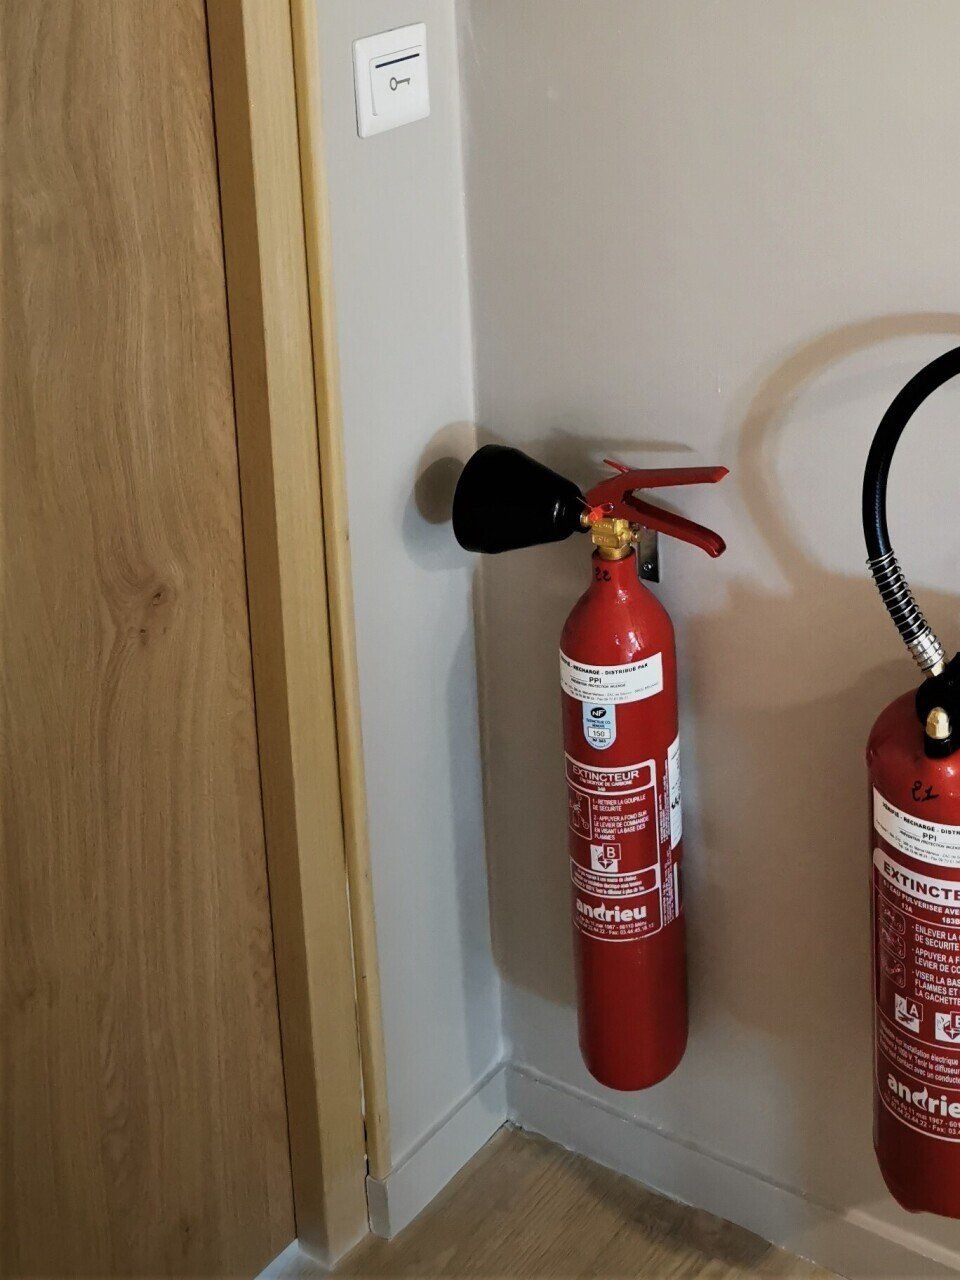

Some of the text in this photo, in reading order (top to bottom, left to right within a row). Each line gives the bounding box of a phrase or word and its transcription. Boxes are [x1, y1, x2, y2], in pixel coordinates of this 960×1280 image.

[589, 676, 602, 684] PPI
[592, 709, 605, 717] NF
[572, 765, 639, 782] EXTINCTEUR
[922, 832, 937, 841] PPI
[606, 847, 616, 858] B
[576, 898, 647, 922] andrieu
[901, 892, 943, 914] PULVERISEE
[915, 924, 946, 939] ENLEVER
[947, 932, 958, 941] LA
[915, 933, 960, 951] DE SECURITE
[915, 947, 947, 963] APPUYER
[915, 956, 938, 971] LEVIER
[939, 964, 949, 973] DE
[915, 969, 935, 981] VISER
[935, 976, 945, 985] LA
[915, 979, 947, 996] FLAMMES
[948, 987, 958, 996] ET
[915, 988, 923, 998] LA
[909, 1004, 919, 1018] A
